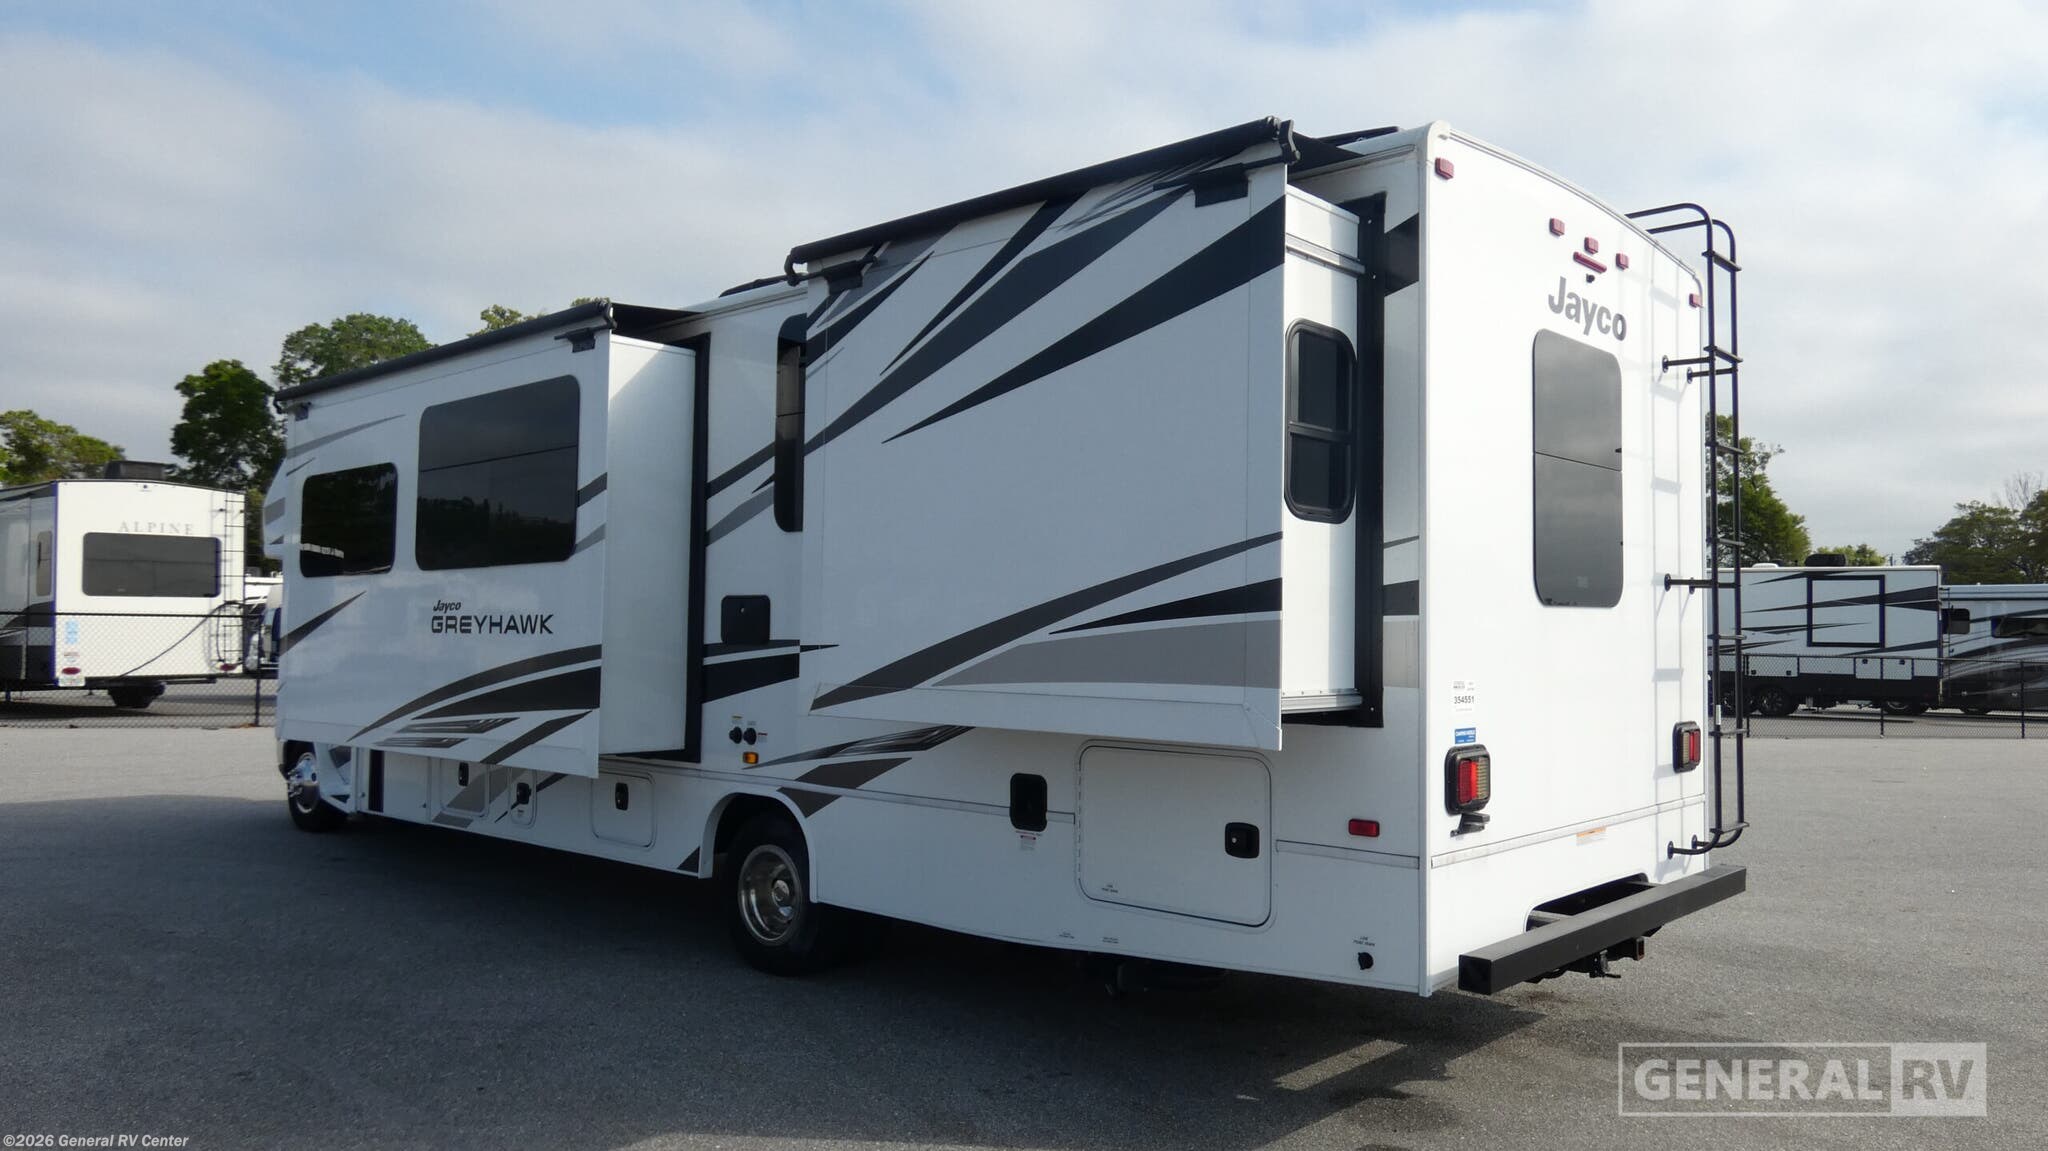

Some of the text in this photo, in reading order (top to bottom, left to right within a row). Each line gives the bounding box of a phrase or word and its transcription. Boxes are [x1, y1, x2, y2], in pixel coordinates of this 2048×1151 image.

[1548, 276, 1627, 341] Jayco
[118, 521, 194, 536] ALPINE
[433, 600, 462, 614] Jayco
[431, 614, 554, 634] GREYHAWK
